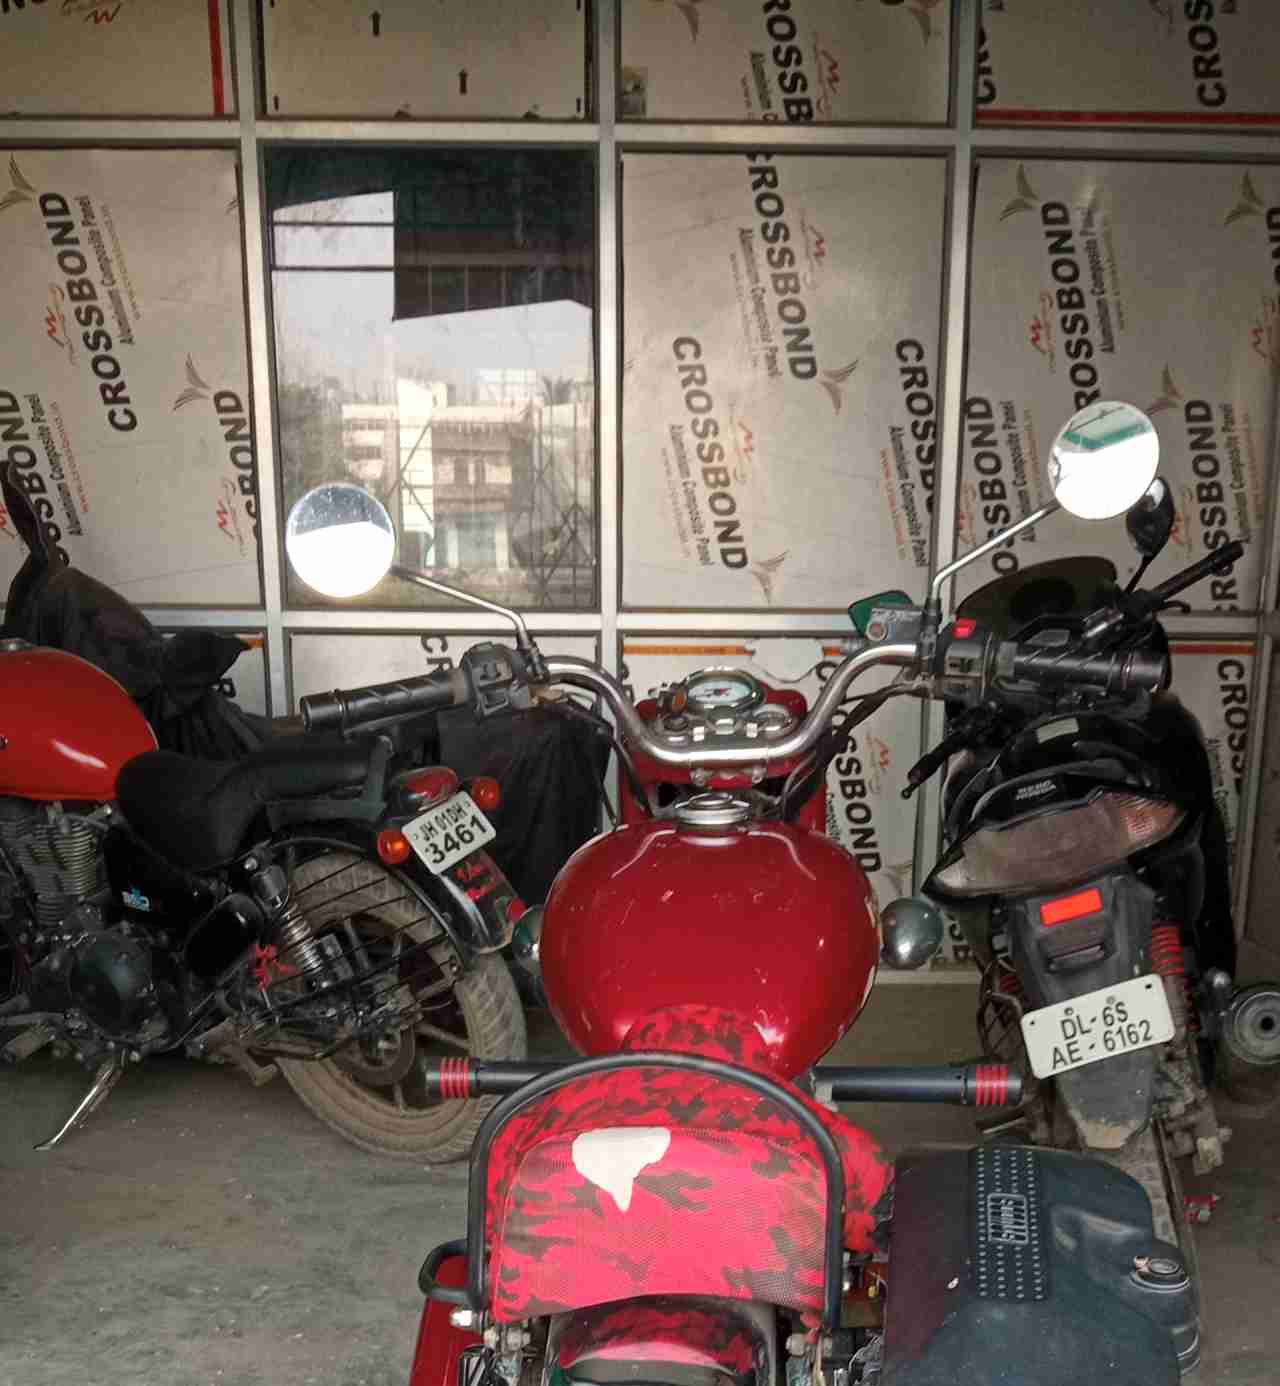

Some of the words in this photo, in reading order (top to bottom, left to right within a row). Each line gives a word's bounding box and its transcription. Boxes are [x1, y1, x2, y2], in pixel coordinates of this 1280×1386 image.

[39, 192, 137, 432] CROSSBOND
[672, 336, 749, 569] CROSSBOND
[419, 820, 439, 842] JH
[429, 814, 487, 863] 3461
